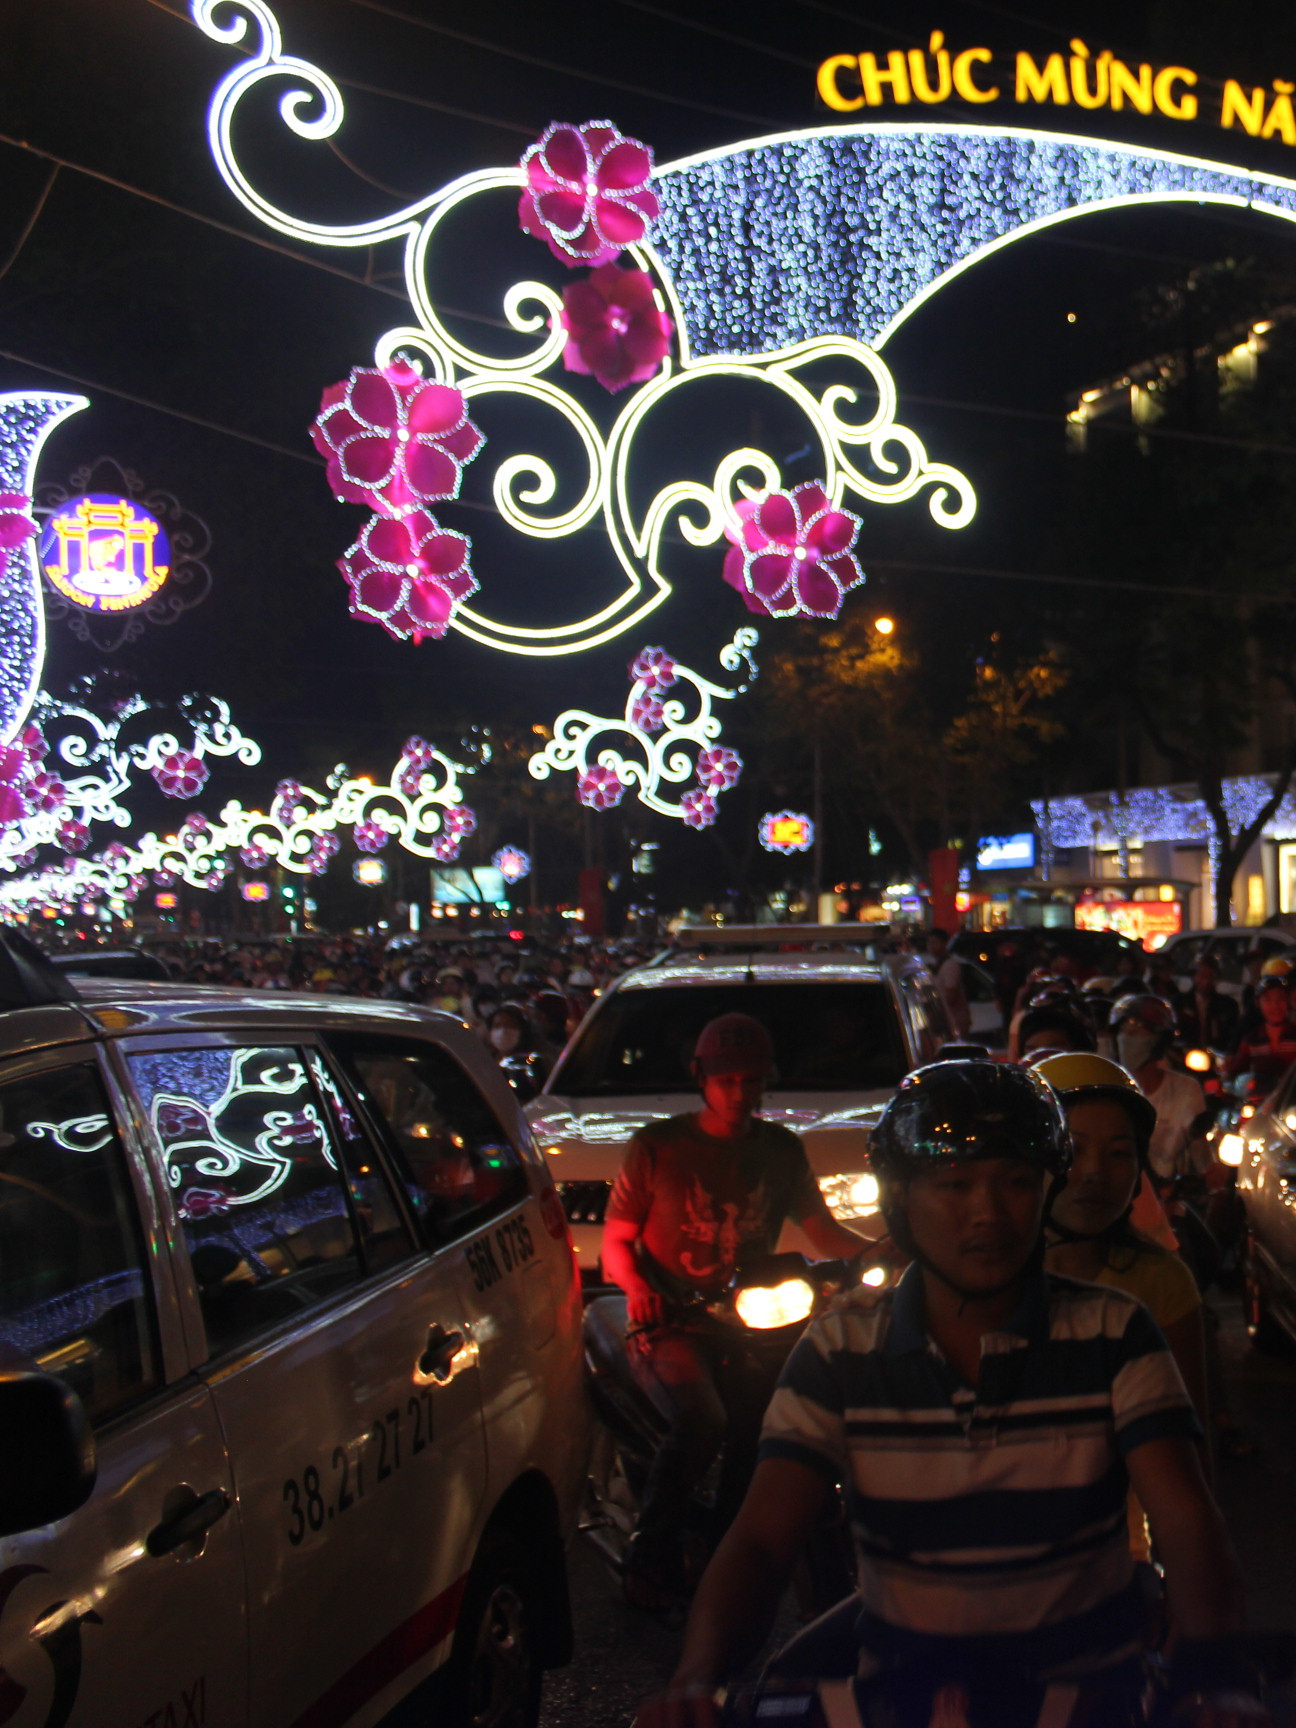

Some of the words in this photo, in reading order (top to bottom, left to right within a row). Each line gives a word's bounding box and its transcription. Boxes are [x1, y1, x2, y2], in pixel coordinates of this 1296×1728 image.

[816, 30, 1000, 112] CHÚC
[1015, 38, 1198, 120] MỪNG
[283, 1440, 364, 1546] 38.27
[372, 1409, 399, 1484] 27
[408, 1387, 434, 1455] 27
